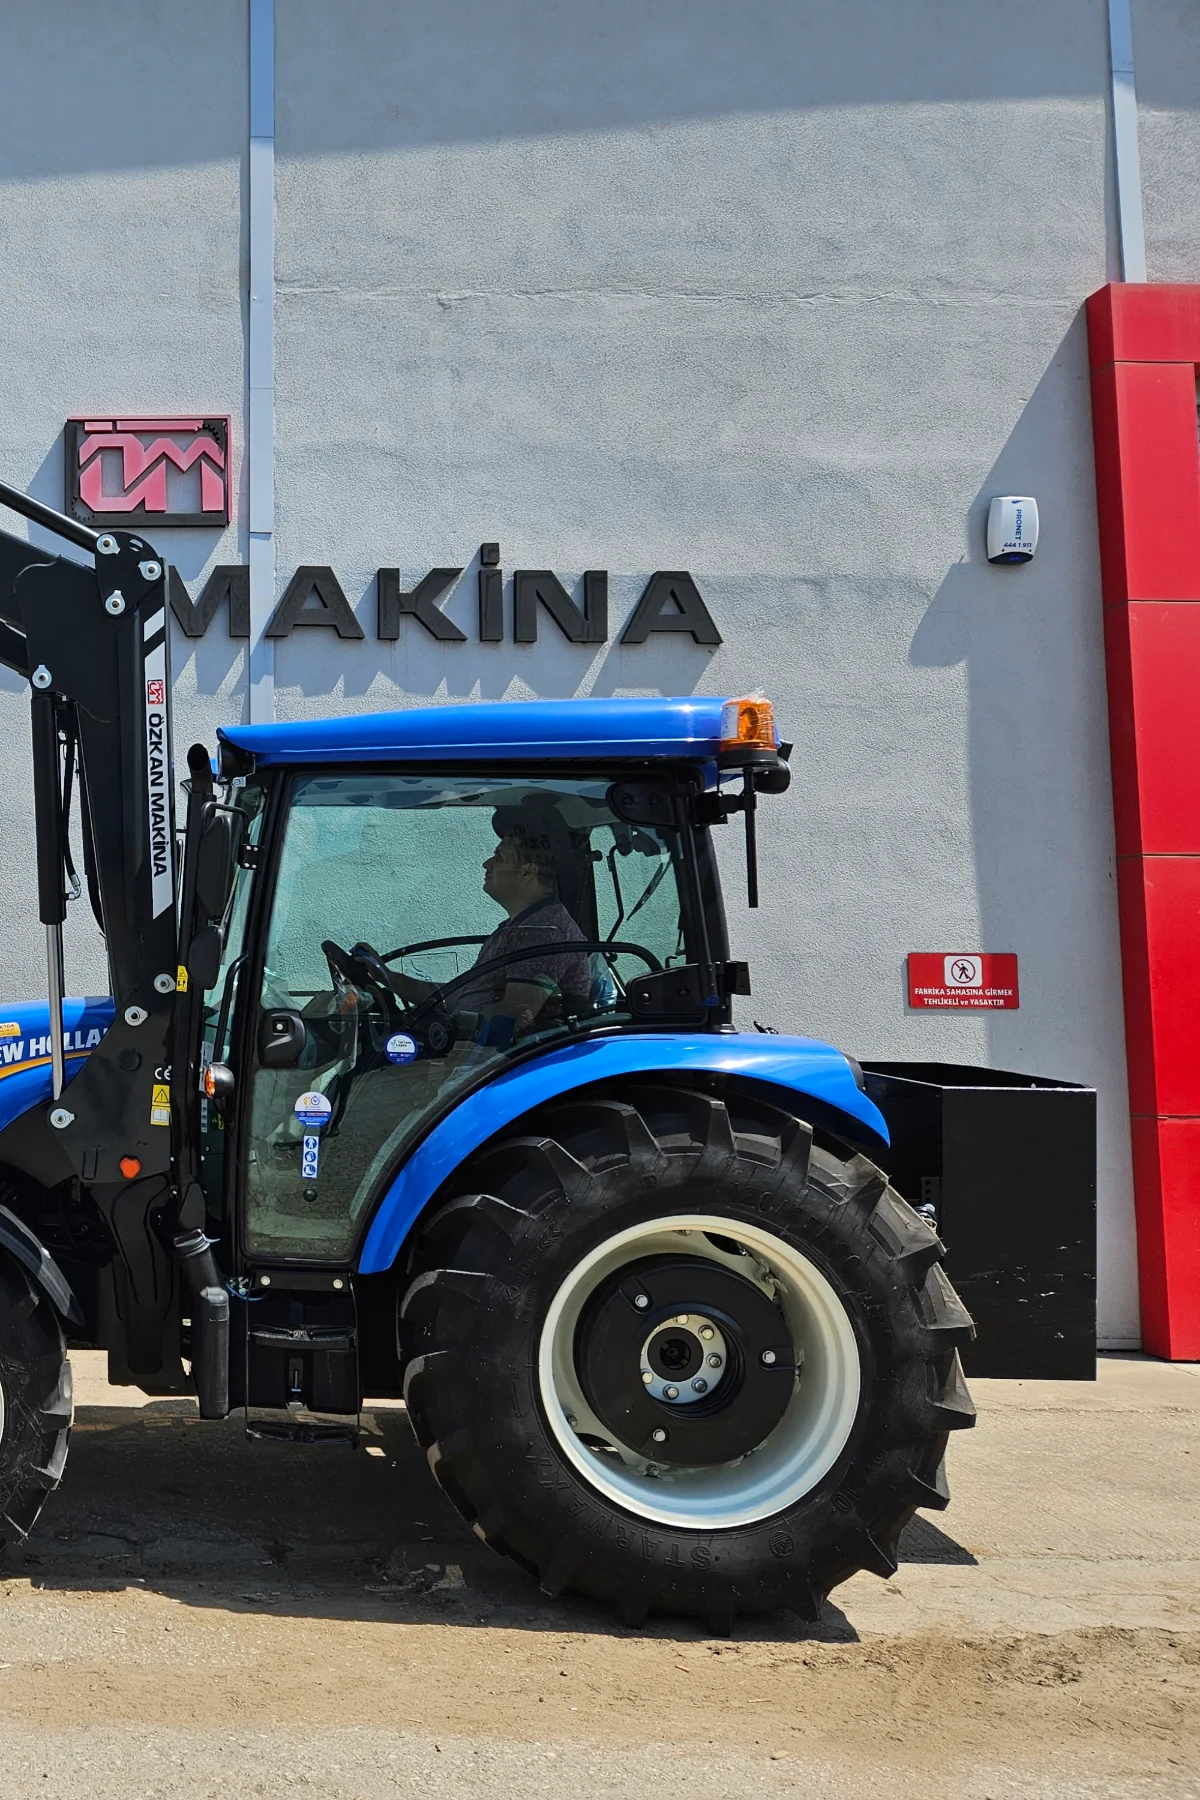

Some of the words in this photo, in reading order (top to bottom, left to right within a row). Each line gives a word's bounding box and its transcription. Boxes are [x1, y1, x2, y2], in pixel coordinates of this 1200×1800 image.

[166, 542, 723, 645] MAKİNA
[148, 713, 164, 787] ÖZKAN
[150, 792, 170, 877] MAKİNA
[914, 986, 945, 996] FABRİKA
[946, 988, 984, 996] SAHASINA
[984, 987, 1013, 996] GİRMEK
[923, 998, 959, 1006] TEHLİKELİ
[969, 998, 1005, 1006] YASAKTIR
[29, 1028, 109, 1058] HLLA
